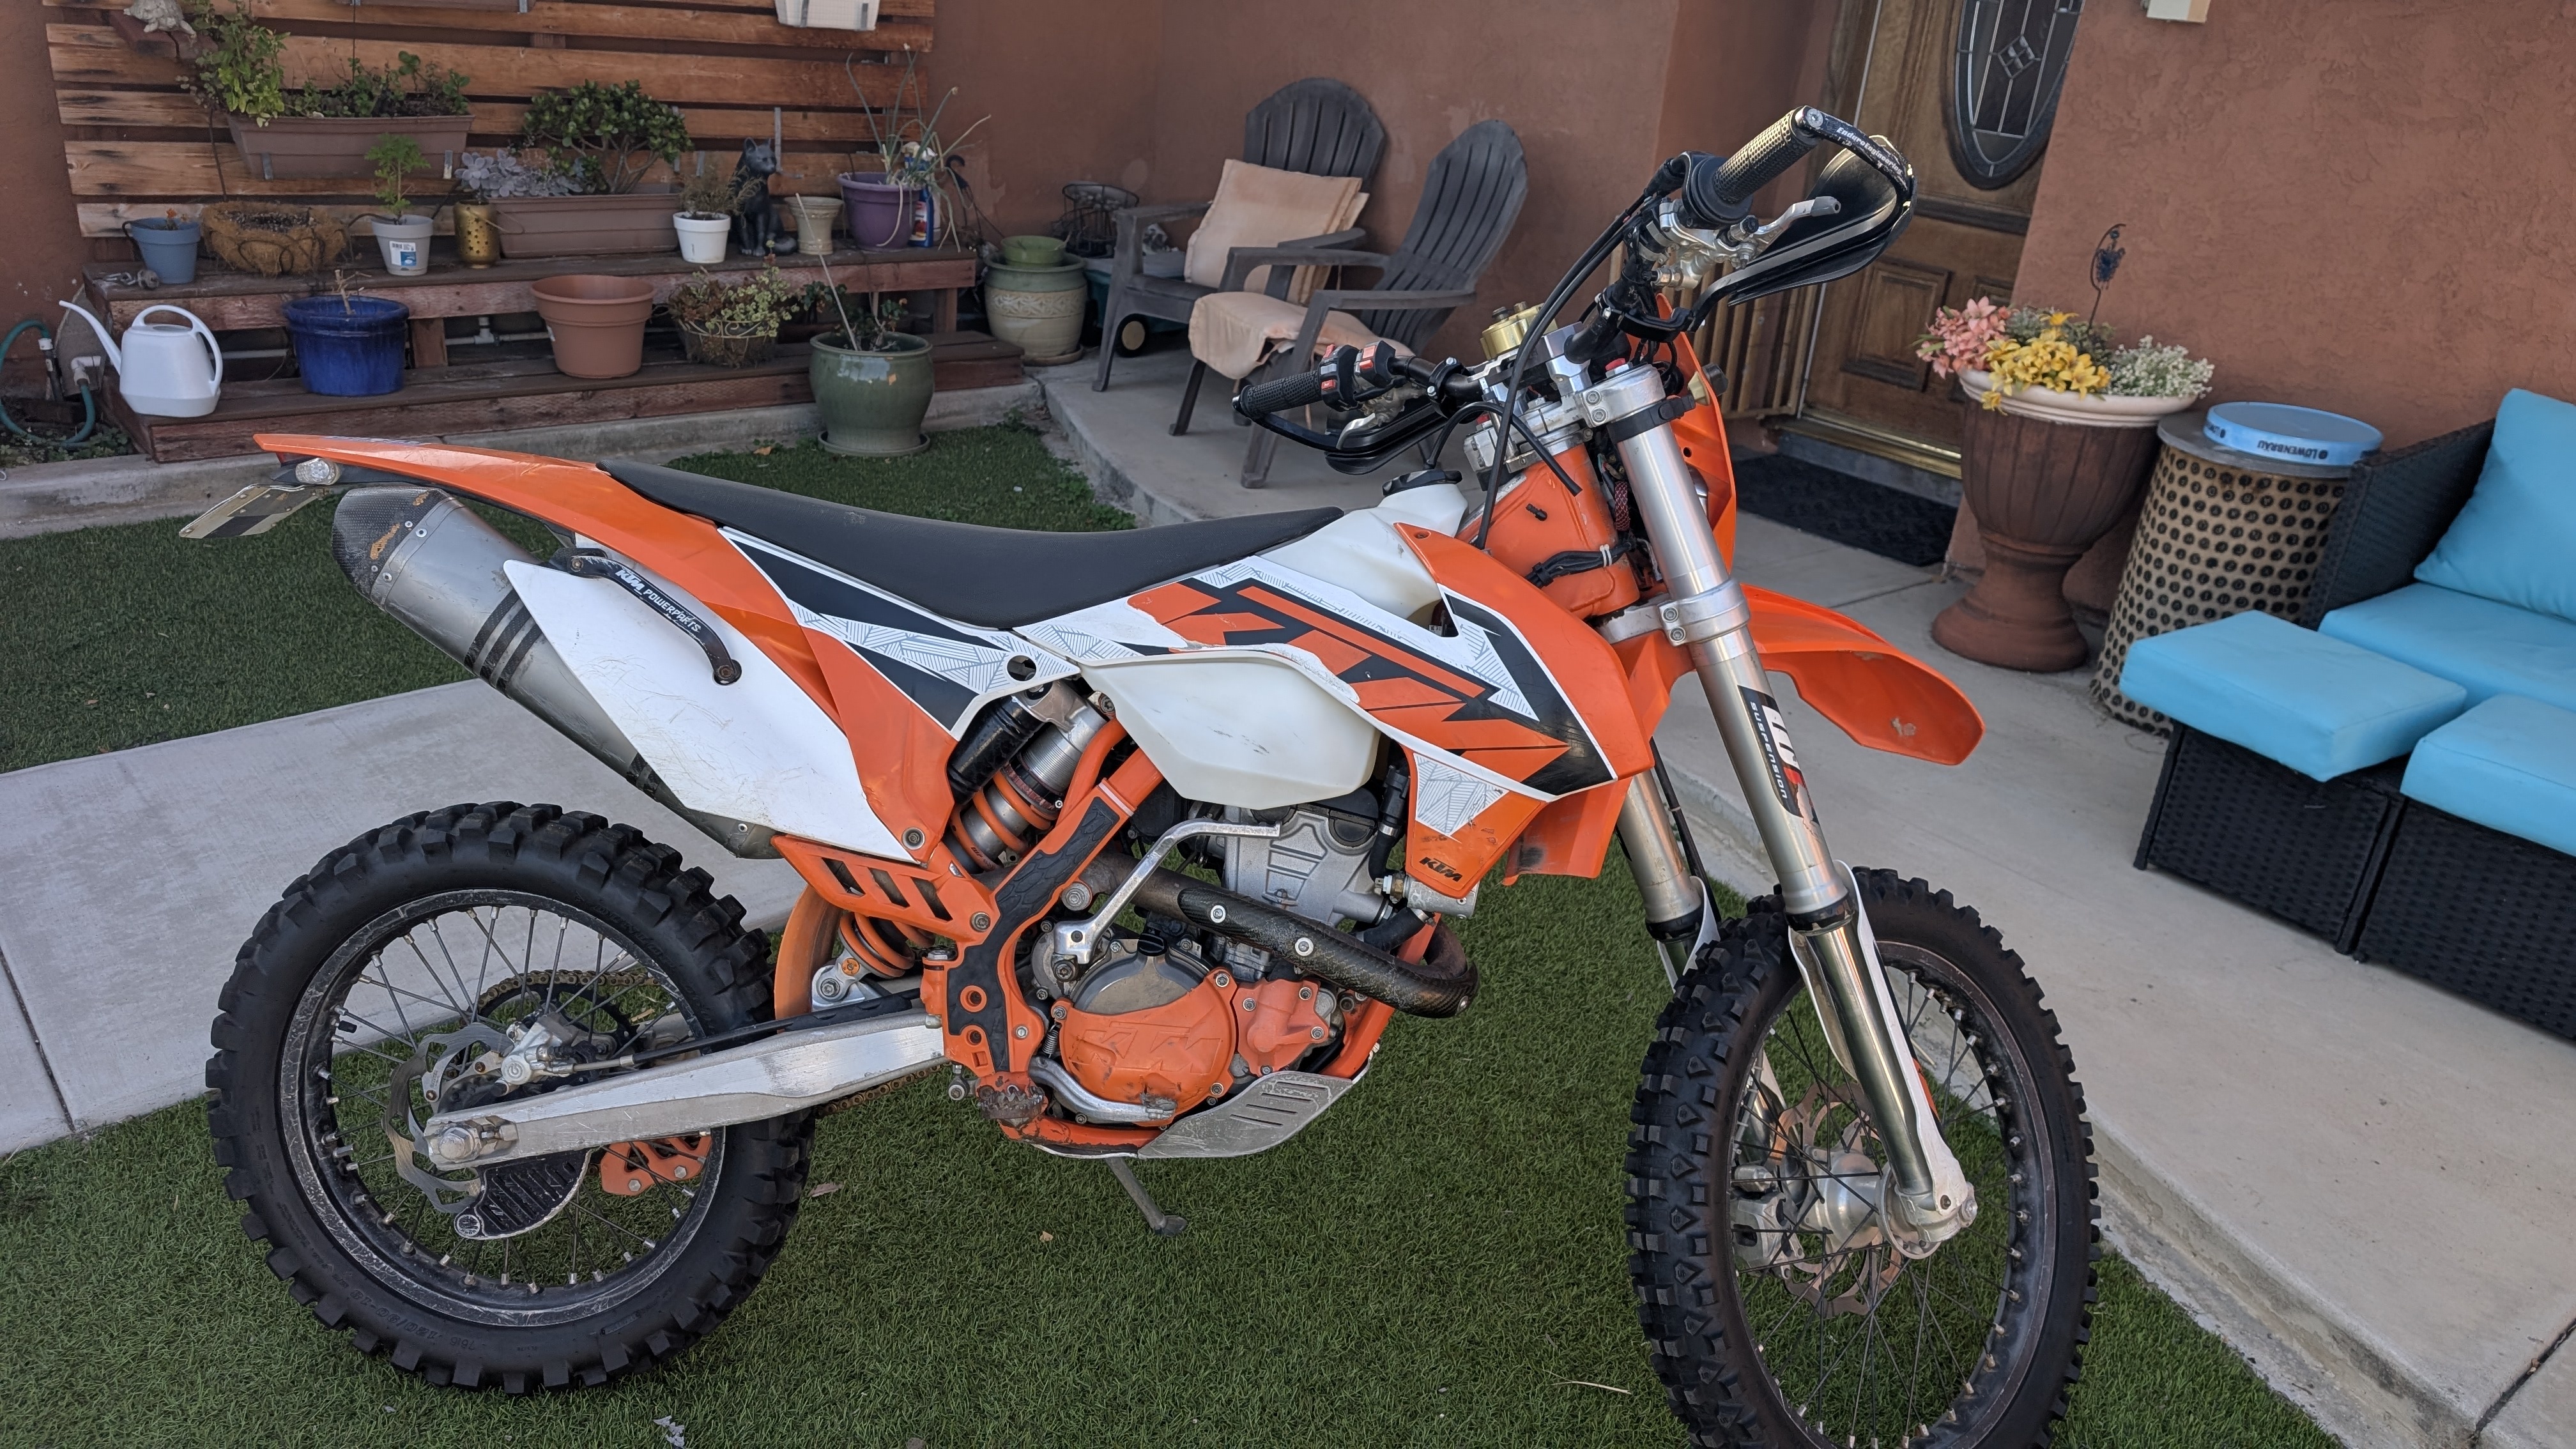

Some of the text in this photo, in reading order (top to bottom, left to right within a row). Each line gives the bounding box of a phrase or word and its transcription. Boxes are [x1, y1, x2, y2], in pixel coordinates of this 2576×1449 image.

[615, 569, 702, 632] KTM POWERPARTS
[1750, 701, 1788, 799] SUSPENSION
[1419, 857, 1463, 882] KTM
[1068, 1020, 1222, 1075] KTM
